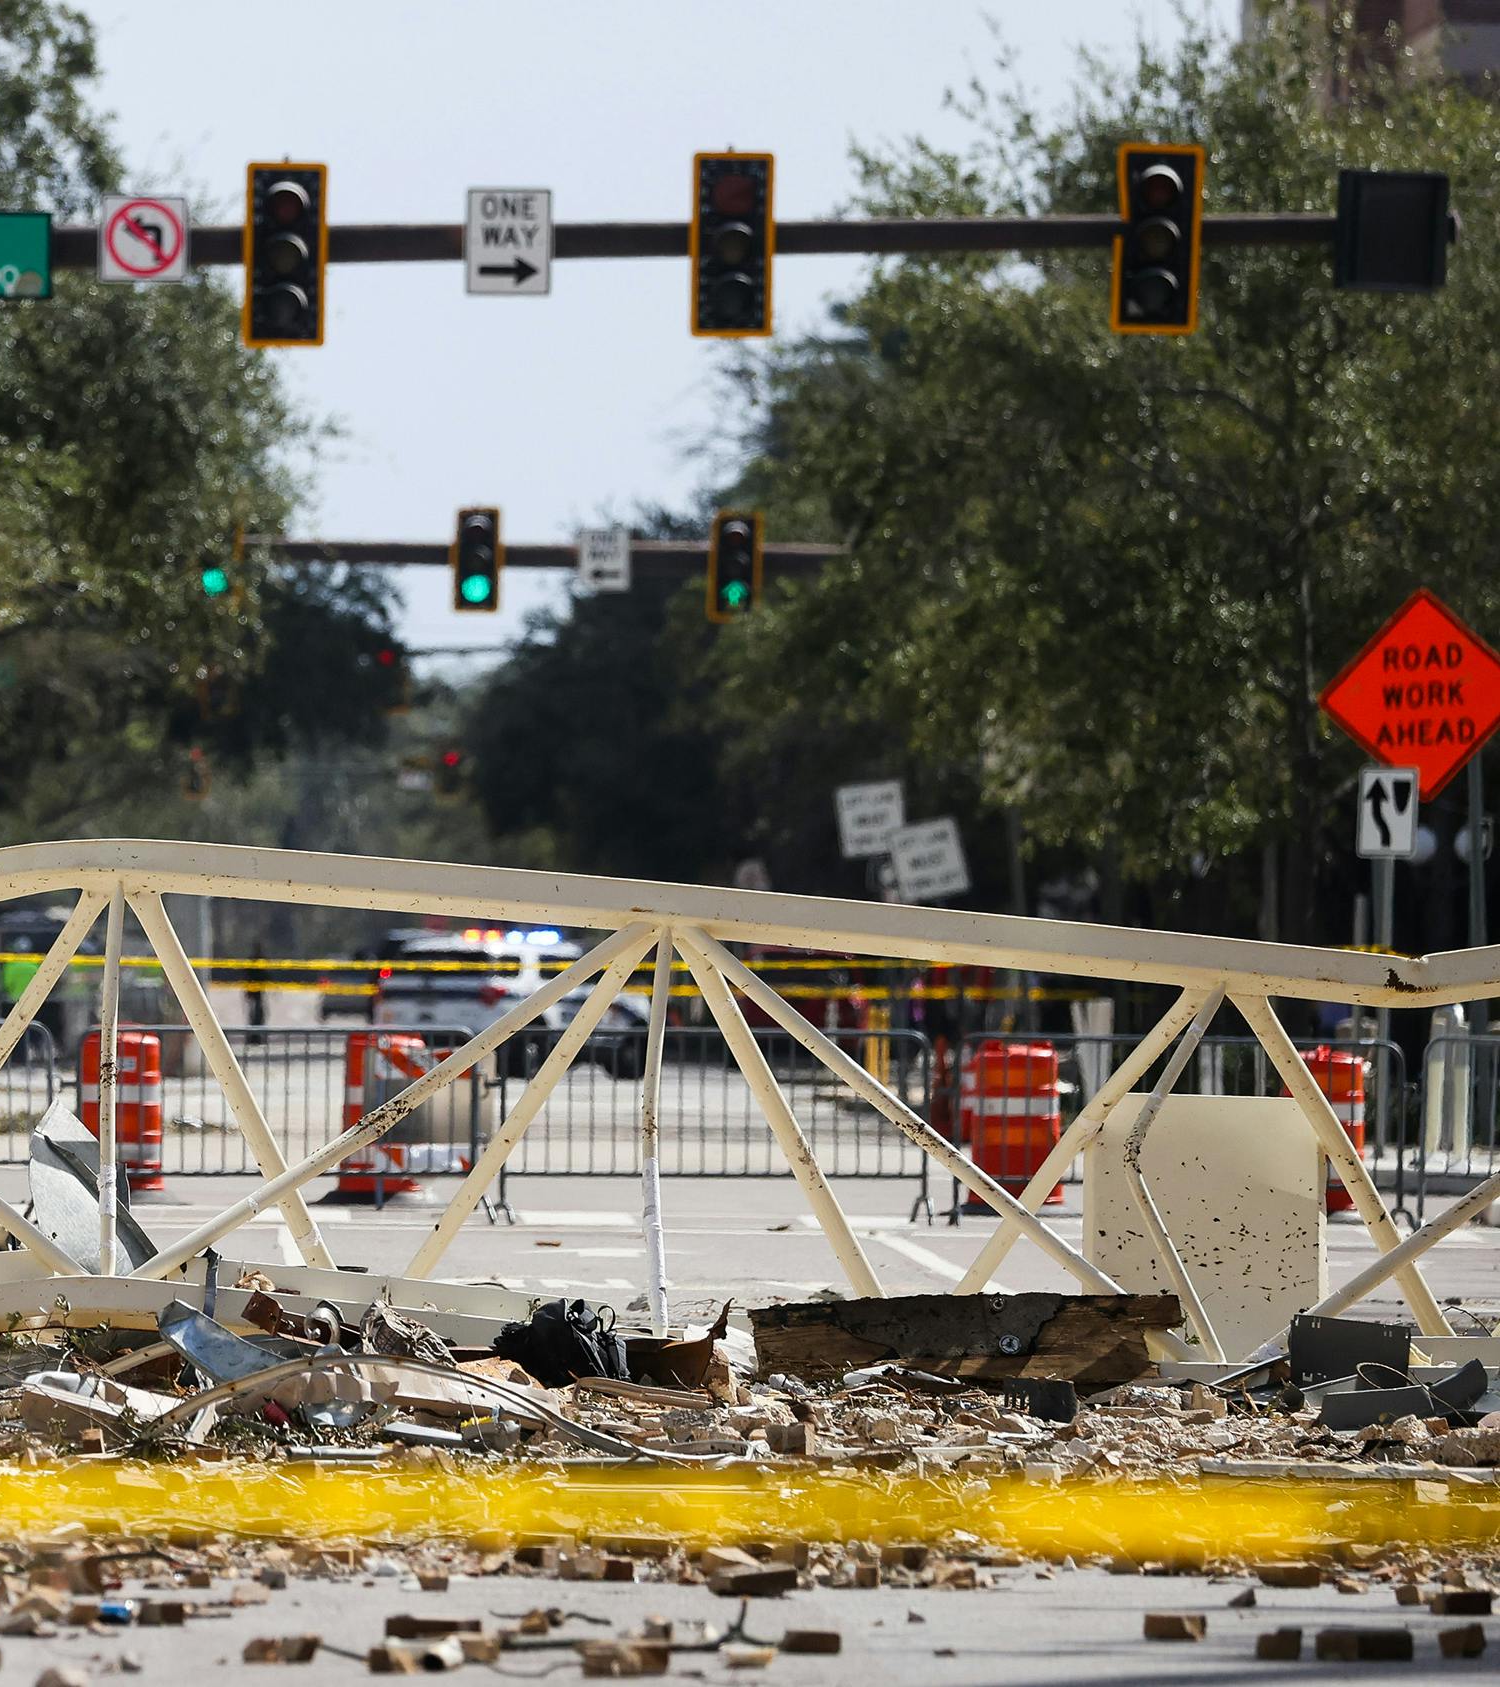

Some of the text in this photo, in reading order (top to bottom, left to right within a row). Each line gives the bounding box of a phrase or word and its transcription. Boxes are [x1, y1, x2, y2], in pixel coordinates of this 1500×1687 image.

[481, 195, 536, 220] ONE
[481, 223, 540, 248] WAY
[1383, 643, 1463, 671] ROAD
[1382, 680, 1464, 710] WORK
[1377, 717, 1475, 747] AHEAD
